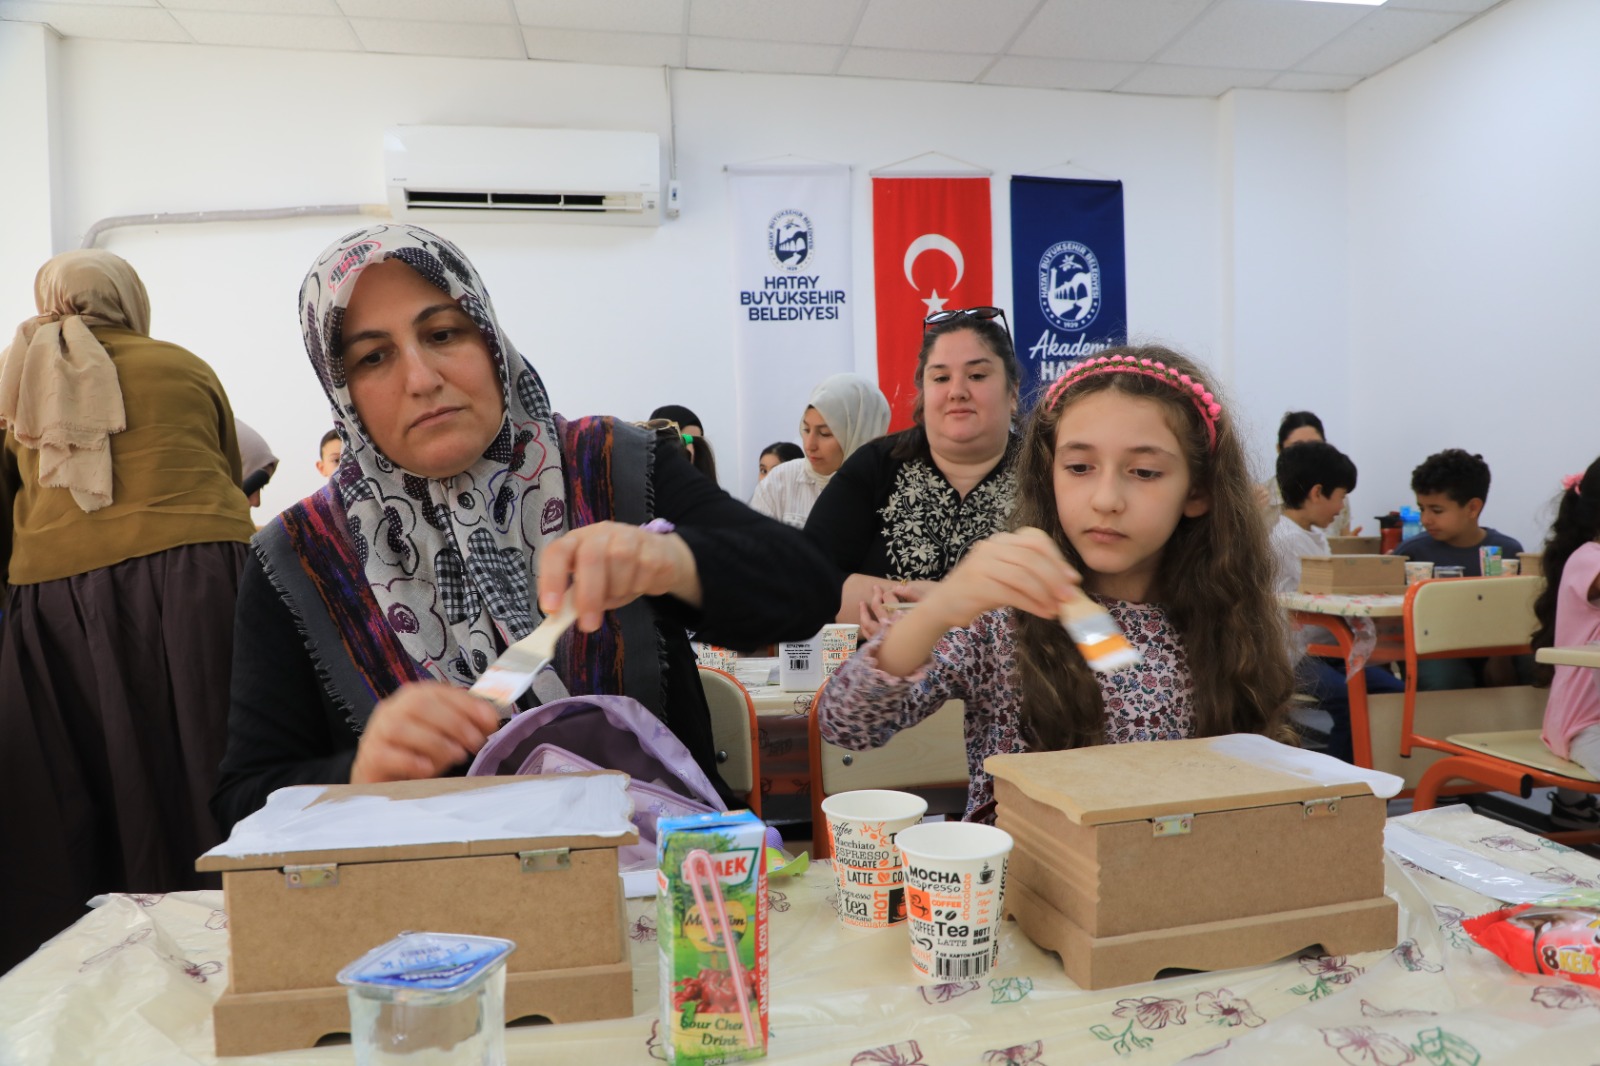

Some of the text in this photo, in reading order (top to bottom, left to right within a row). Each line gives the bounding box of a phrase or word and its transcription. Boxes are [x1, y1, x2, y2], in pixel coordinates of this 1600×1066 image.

[764, 275, 820, 290] HATAY
[832, 821, 852, 837] coffee
[836, 855, 878, 869] CHOCOLATE
[847, 870, 874, 885] LATTE
[909, 865, 962, 884] MOCHA
[910, 878, 961, 893] espresso
[932, 899, 962, 908] COFFEE
[961, 873, 972, 921] chocolate
[845, 896, 868, 917] tea
[873, 890, 888, 921] HOT
[935, 921, 969, 938] Tea
[937, 938, 968, 947] LATTE
[702, 1033, 740, 1046] Drink
